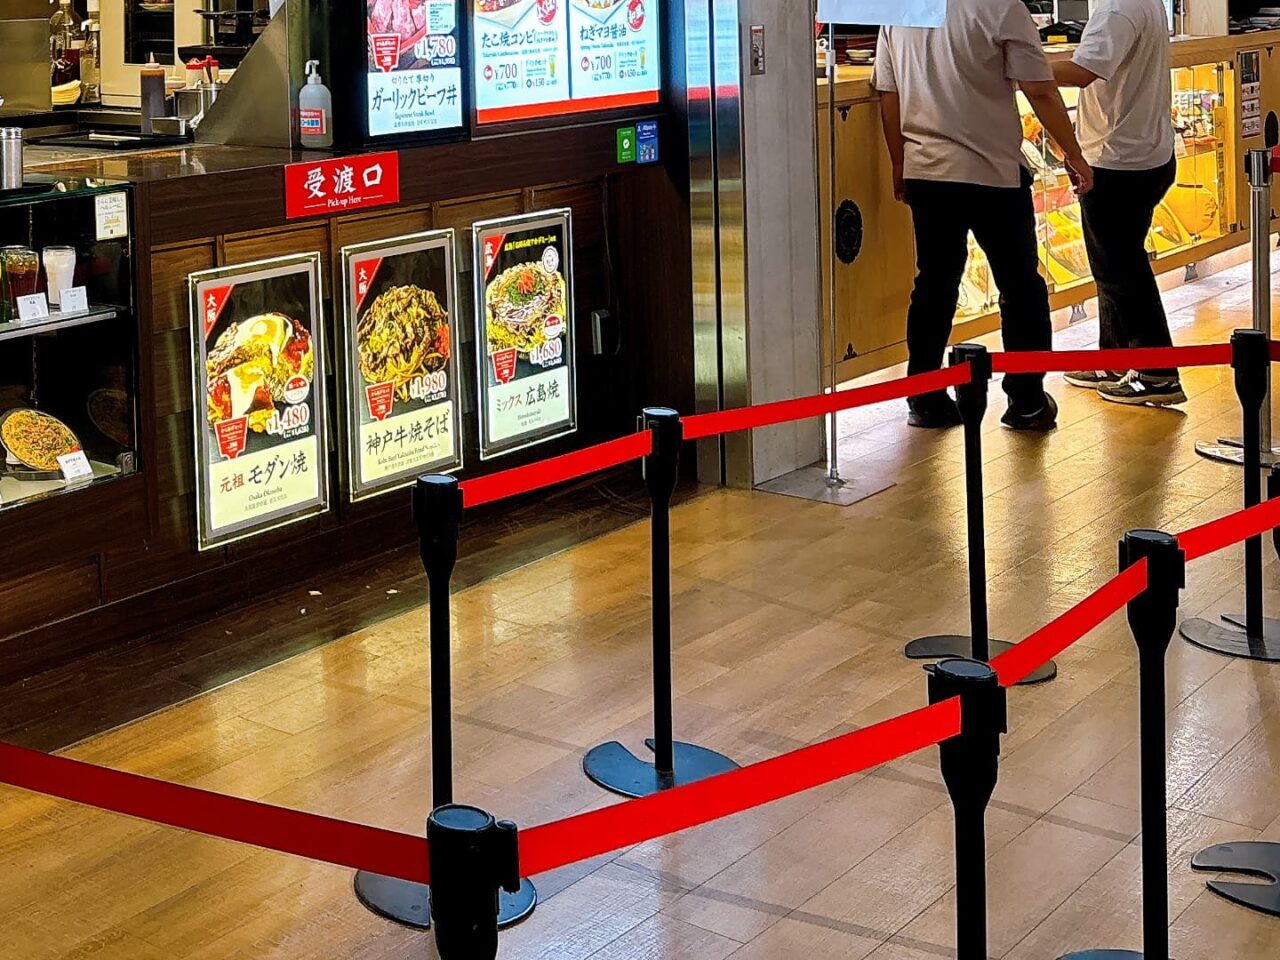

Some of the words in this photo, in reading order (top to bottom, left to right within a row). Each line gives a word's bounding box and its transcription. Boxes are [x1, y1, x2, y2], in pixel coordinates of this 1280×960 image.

[481, 28, 536, 49] たこ焼コンビ
[303, 163, 383, 199] 受渡口
[327, 197, 348, 208] Pick-up
[348, 195, 362, 204] Here
[206, 293, 218, 323] 大阪
[496, 393, 522, 412] ミックス
[525, 378, 560, 407] 広島焼
[366, 408, 450, 456] 神戸牛焼そば
[220, 472, 245, 494] 元祖
[248, 449, 308, 486] モダン焼
